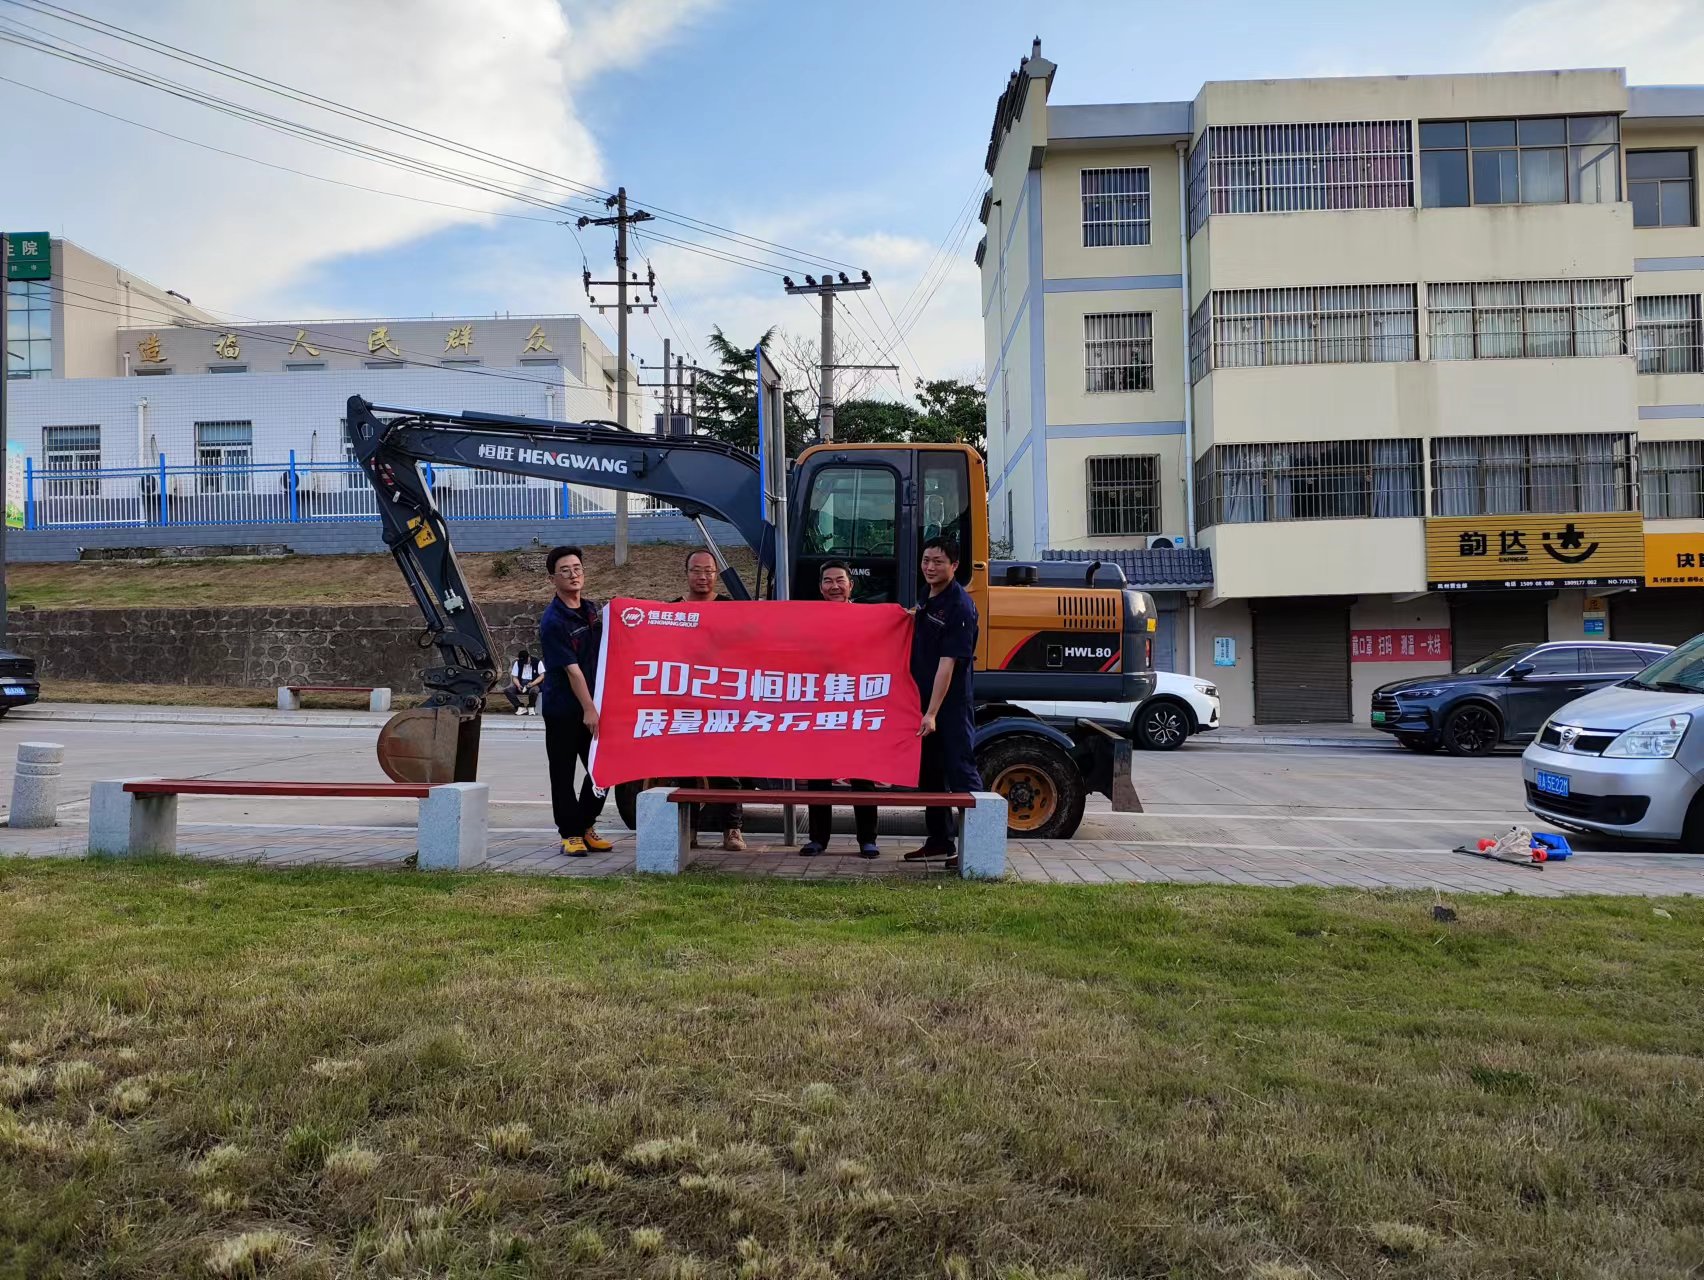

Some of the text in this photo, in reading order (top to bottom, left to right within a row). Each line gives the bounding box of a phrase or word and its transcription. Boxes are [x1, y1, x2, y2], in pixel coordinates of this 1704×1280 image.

[137, 324, 553, 363] 造福人民群众
[478, 443, 628, 474] 恒旺 HENGWANG
[1459, 530, 1528, 556] 韵达
[647, 610, 700, 622] 恒旺集团
[1064, 647, 1112, 658] HWL80
[633, 660, 892, 702] 2023恒旺集团
[633, 708, 886, 738] 质量服务万里行
